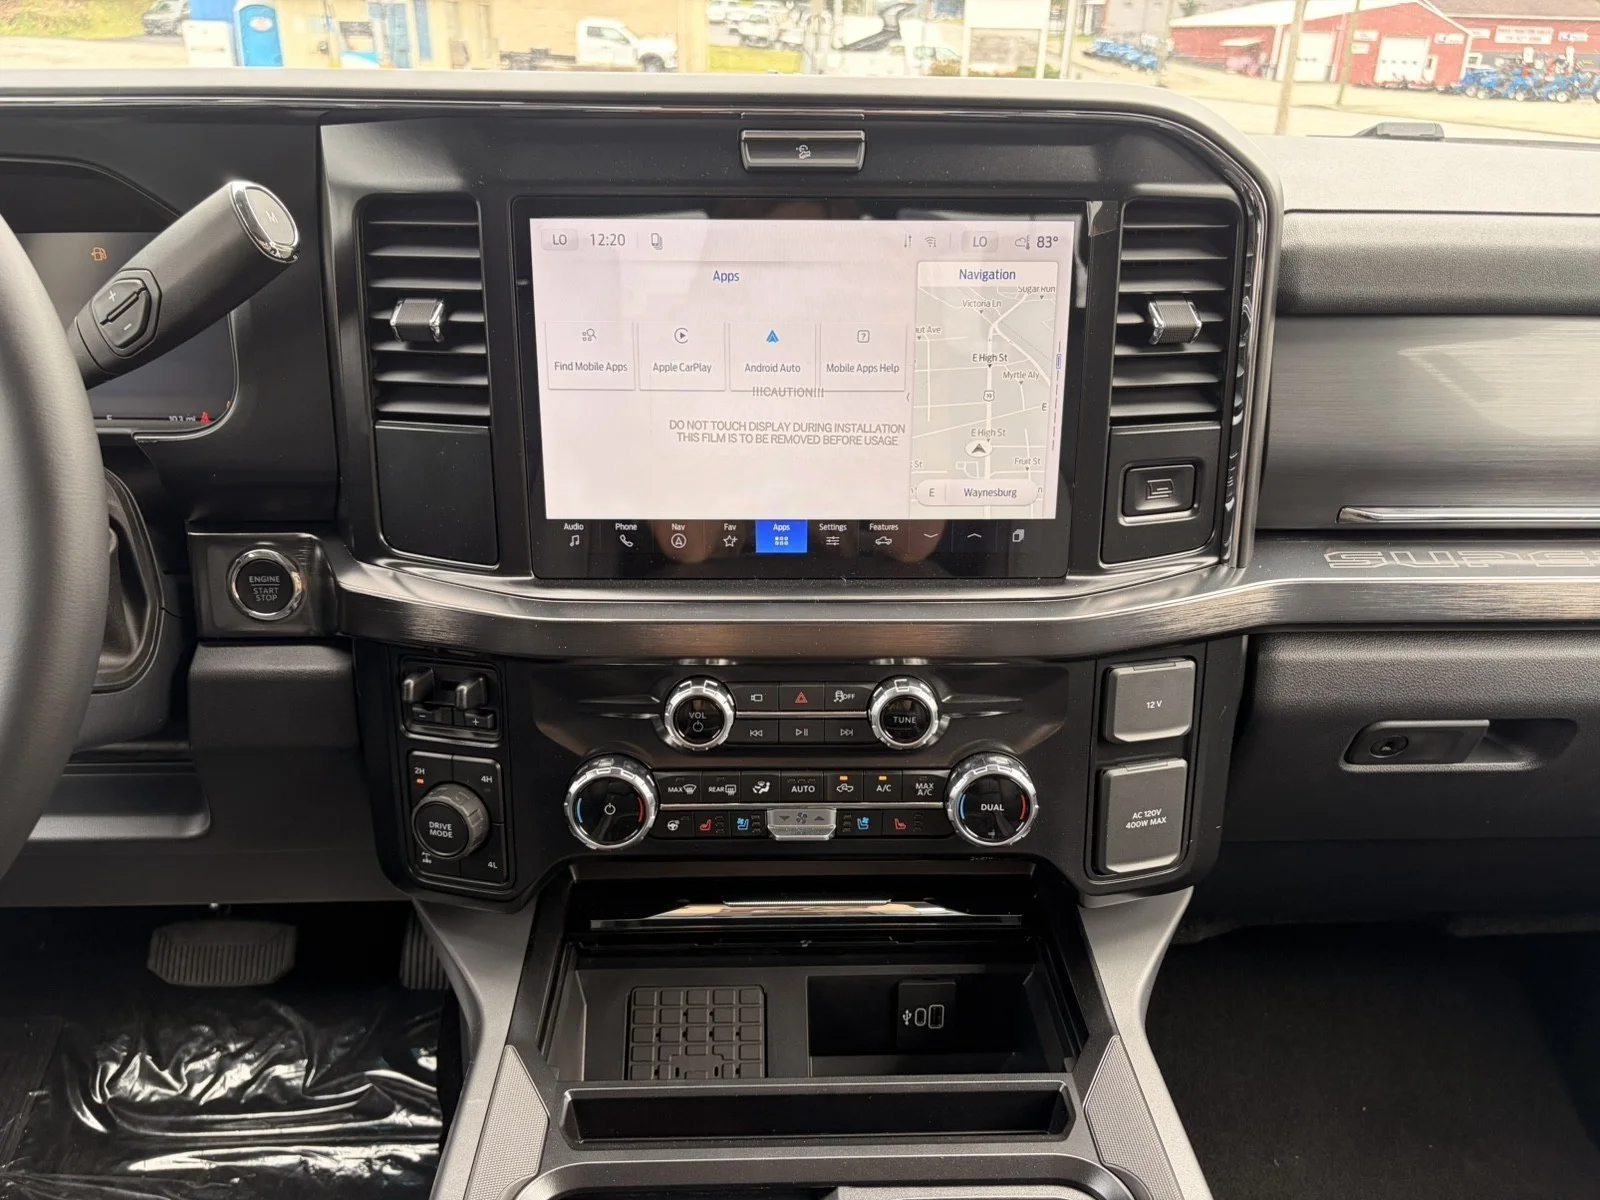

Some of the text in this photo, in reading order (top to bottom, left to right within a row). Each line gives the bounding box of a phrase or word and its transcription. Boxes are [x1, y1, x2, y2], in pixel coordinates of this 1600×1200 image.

[552, 233, 568, 246] LO
[590, 233, 626, 247] 12:20
[972, 236, 988, 248] LO
[1036, 235, 1059, 248] 83°
[712, 270, 740, 283] Apps
[959, 268, 1016, 282] Navigation
[1017, 286, 1040, 294] Sugar
[962, 299, 1002, 308] Victoria Ln
[926, 326, 941, 334] Ave
[972, 353, 1008, 363] E High St
[554, 361, 628, 373] Find Mobile Apps
[652, 362, 712, 374] Apple CarPlay
[744, 363, 801, 373] Android Auto
[826, 363, 900, 374] Mobile Apps Help
[1002, 371, 1040, 380] Myrtle Aly
[669, 419, 906, 434] DO NOT TOUCH DISPLAY DURING INSTALLATION
[970, 429, 1006, 437] E High St
[677, 432, 899, 446] THIS FILM IS TO BE REMOVED BEFORE USAGE
[1014, 457, 1041, 465] Fruit St
[929, 488, 935, 497] E
[963, 487, 1017, 499] Waynesburg
[563, 523, 584, 531] Audio
[615, 523, 638, 531] Phone
[671, 523, 686, 531] Nav
[723, 523, 737, 531] Fav
[773, 523, 790, 532] Apps
[819, 523, 847, 532] Settings
[869, 523, 899, 531] Features
[1323, 551, 1600, 569] SUPE
[248, 575, 281, 583] ENGINE
[252, 587, 280, 595] START
[255, 594, 278, 602] STOP
[843, 692, 856, 700] OFF
[1146, 700, 1163, 709] 12 V
[688, 711, 707, 720] VOL
[893, 716, 917, 724] TUNE
[414, 767, 426, 775] 2H
[480, 775, 493, 783] 4H
[791, 785, 815, 793] AUTO
[876, 784, 892, 793] A/C
[917, 788, 933, 797] A/C
[980, 803, 1005, 811] DUAL
[1132, 808, 1162, 820] AC 120V
[428, 821, 453, 831] DRIVE
[1125, 816, 1167, 829] 400W MAX
[429, 829, 453, 838] MODE
[487, 861, 498, 869] 4L
